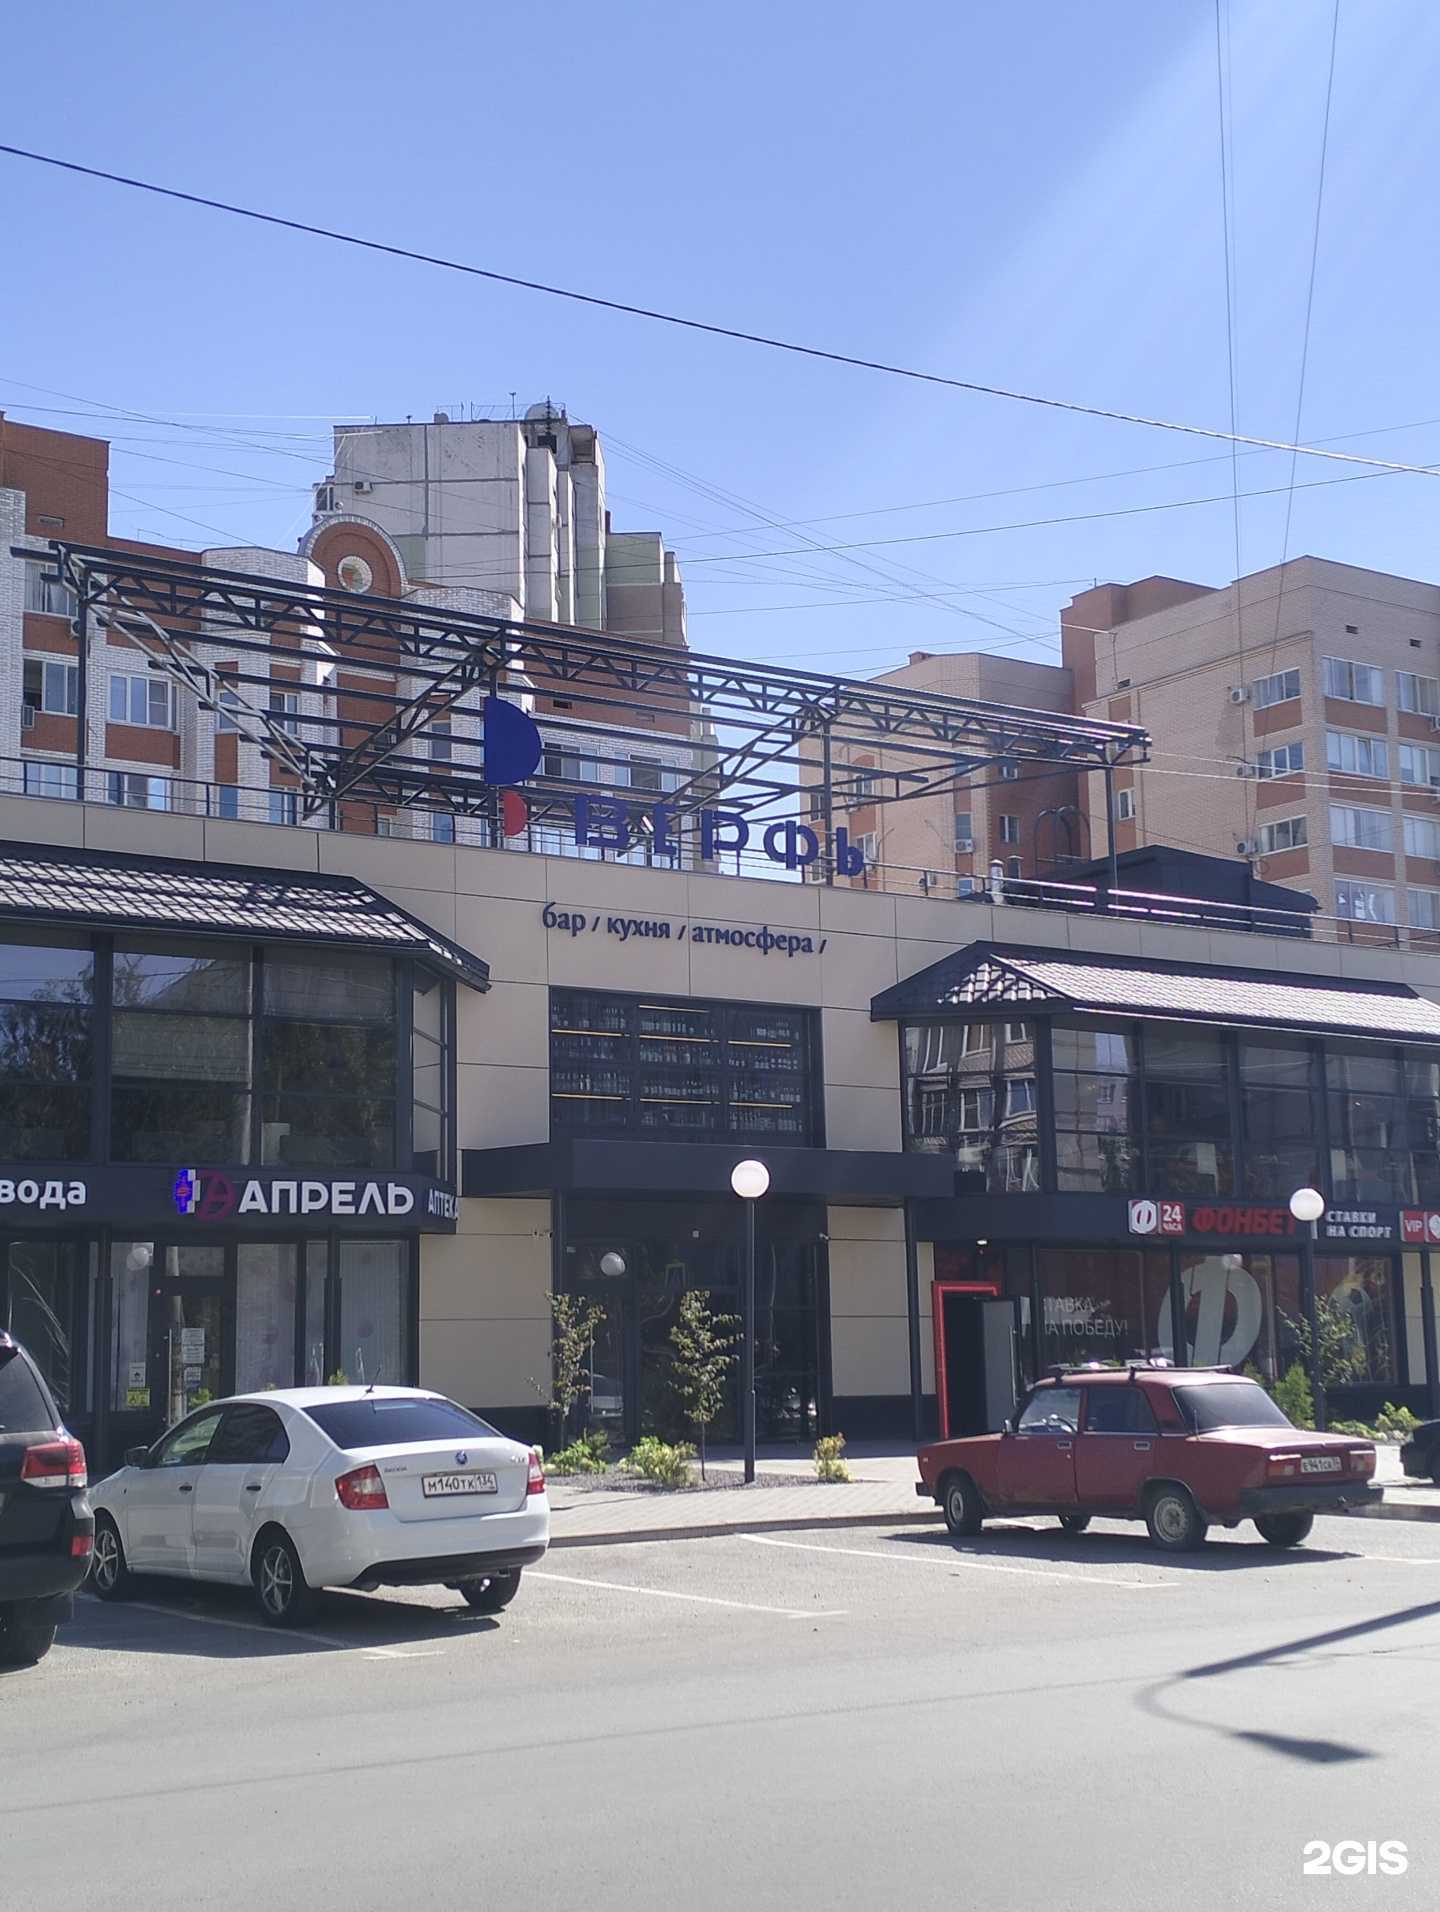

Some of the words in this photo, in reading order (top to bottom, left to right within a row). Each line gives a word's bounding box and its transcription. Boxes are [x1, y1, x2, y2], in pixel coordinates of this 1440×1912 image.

[575, 793, 865, 878] ВЕРФЬ
[542, 901, 586, 937] бар
[607, 916, 671, 942] кухня
[692, 925, 814, 958] атмосфера
[238, 1180, 415, 1215] АПРЕЛЬ
[1162, 1204, 1183, 1222] 24
[1326, 1210, 1377, 1224] СТАВКИ
[1326, 1225, 1347, 1238] НА
[1348, 1226, 1393, 1239] СПОРТ
[1404, 1218, 1423, 1233] VIP
